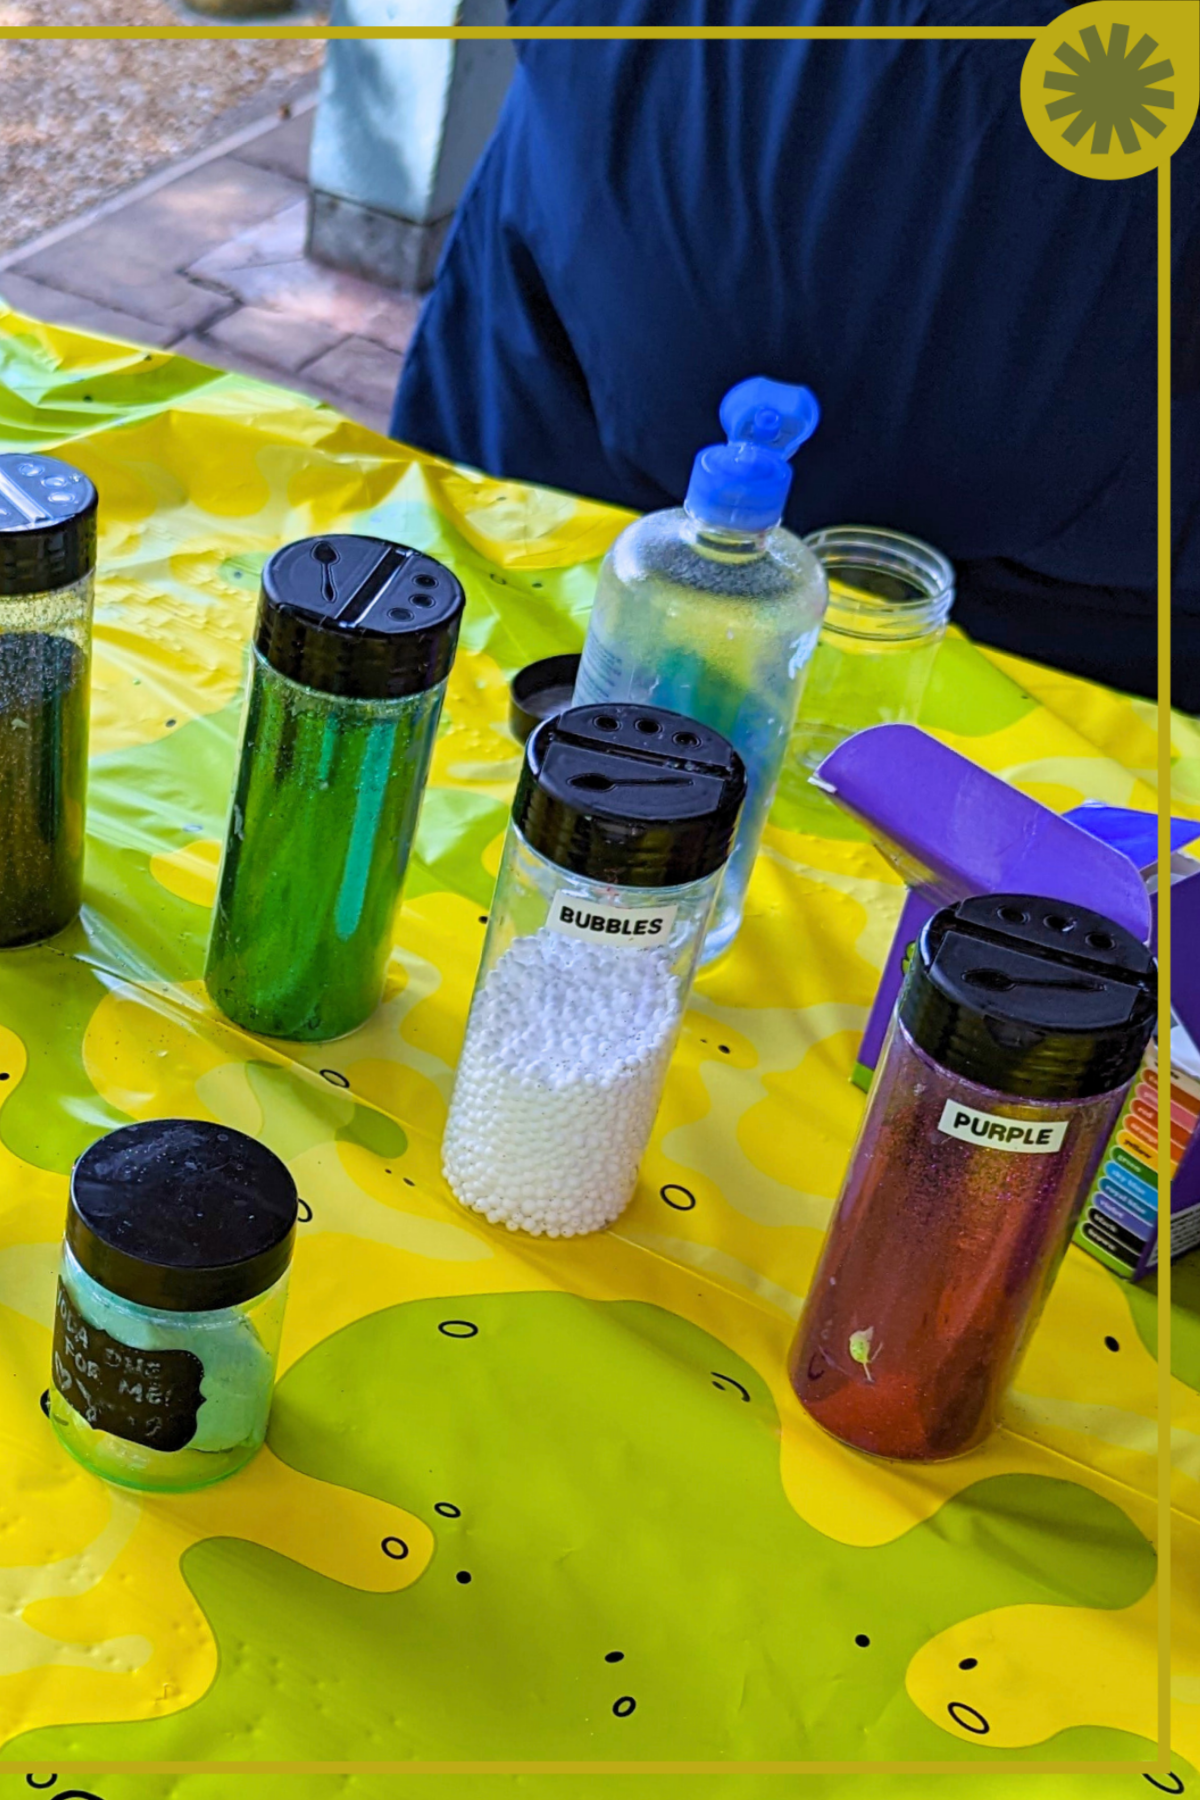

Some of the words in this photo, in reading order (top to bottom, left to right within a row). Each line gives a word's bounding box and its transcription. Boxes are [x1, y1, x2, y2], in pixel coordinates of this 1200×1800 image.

[559, 905, 663, 935] BUBBLES
[953, 1112, 1054, 1145] PURPLE
[1123, 1139, 1152, 1159] yellow
[1117, 1154, 1142, 1173] green
